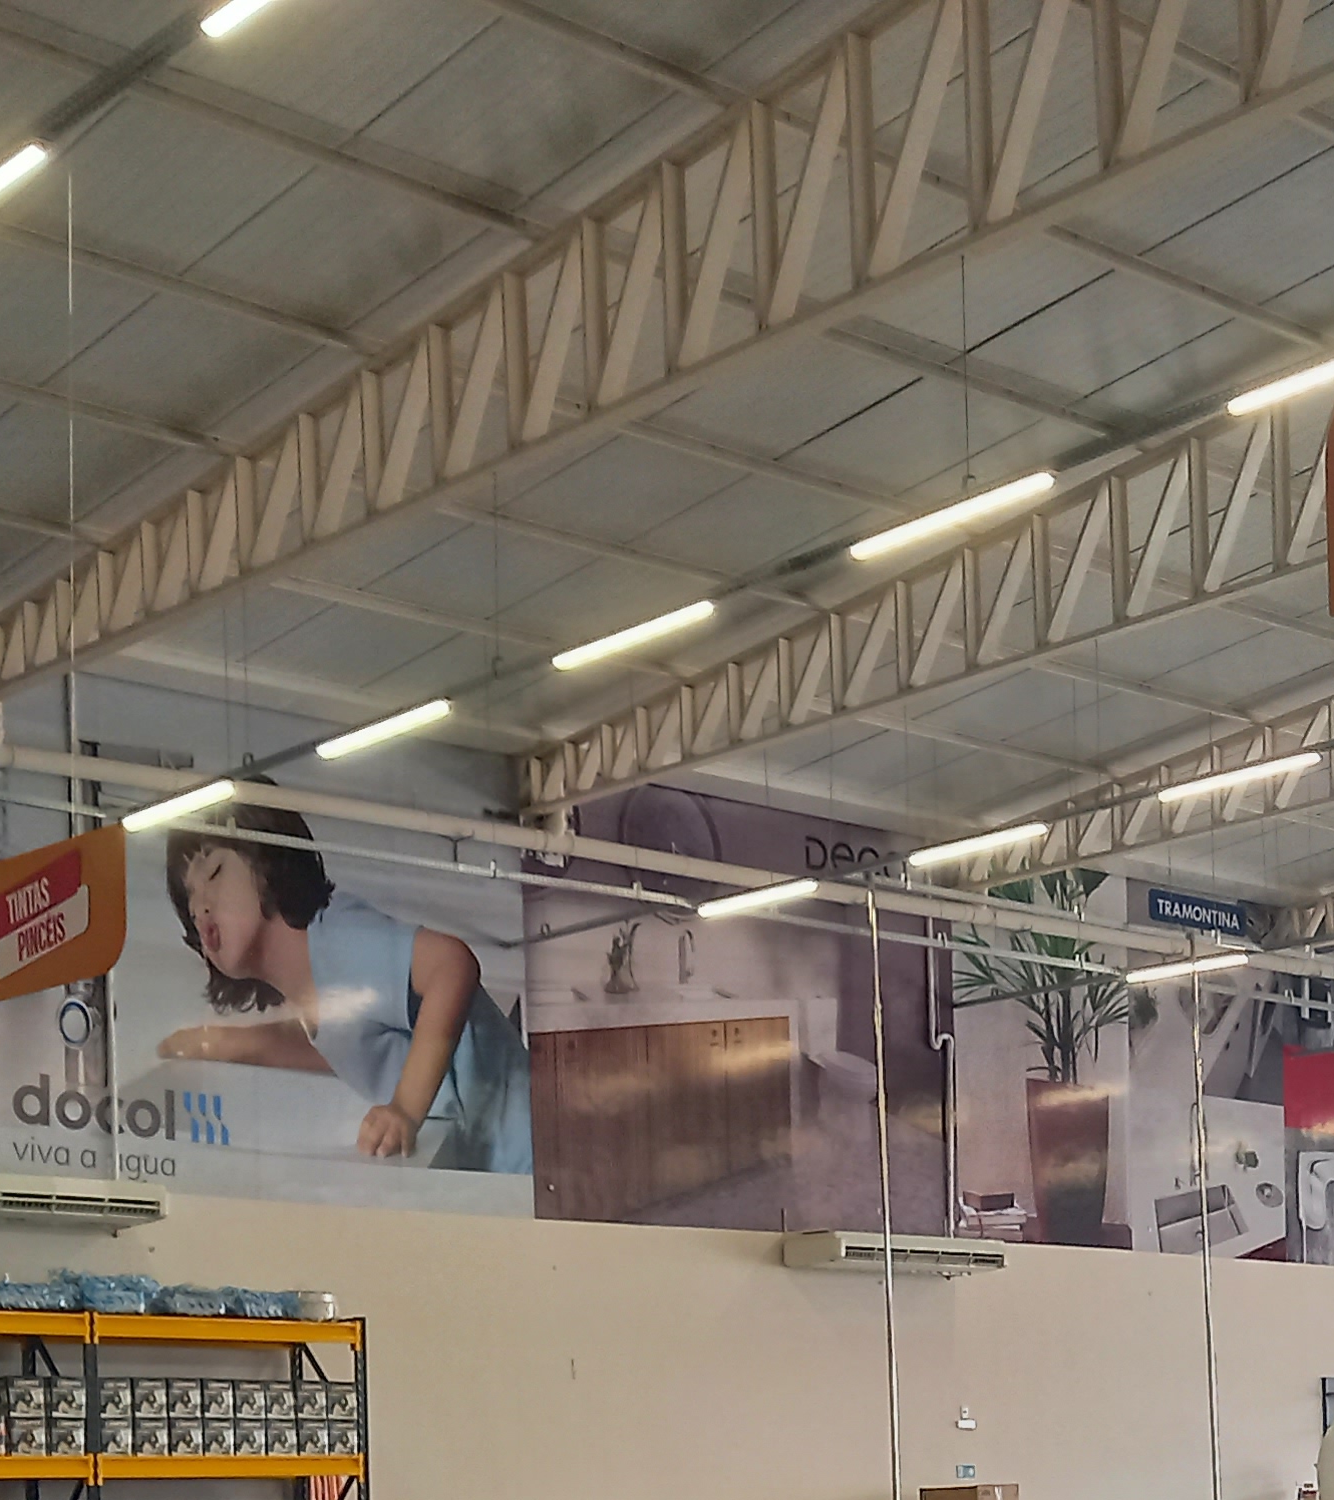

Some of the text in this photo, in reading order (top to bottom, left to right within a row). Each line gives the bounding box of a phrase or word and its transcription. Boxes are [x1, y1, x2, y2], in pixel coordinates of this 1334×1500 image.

[5, 876, 50, 925] TINTAS
[1156, 898, 1241, 931] TRAMONTINA
[17, 912, 66, 962] PINCÉIS
[12, 1072, 177, 1141] docol
[12, 1136, 71, 1167] viva
[79, 1148, 97, 1170] a
